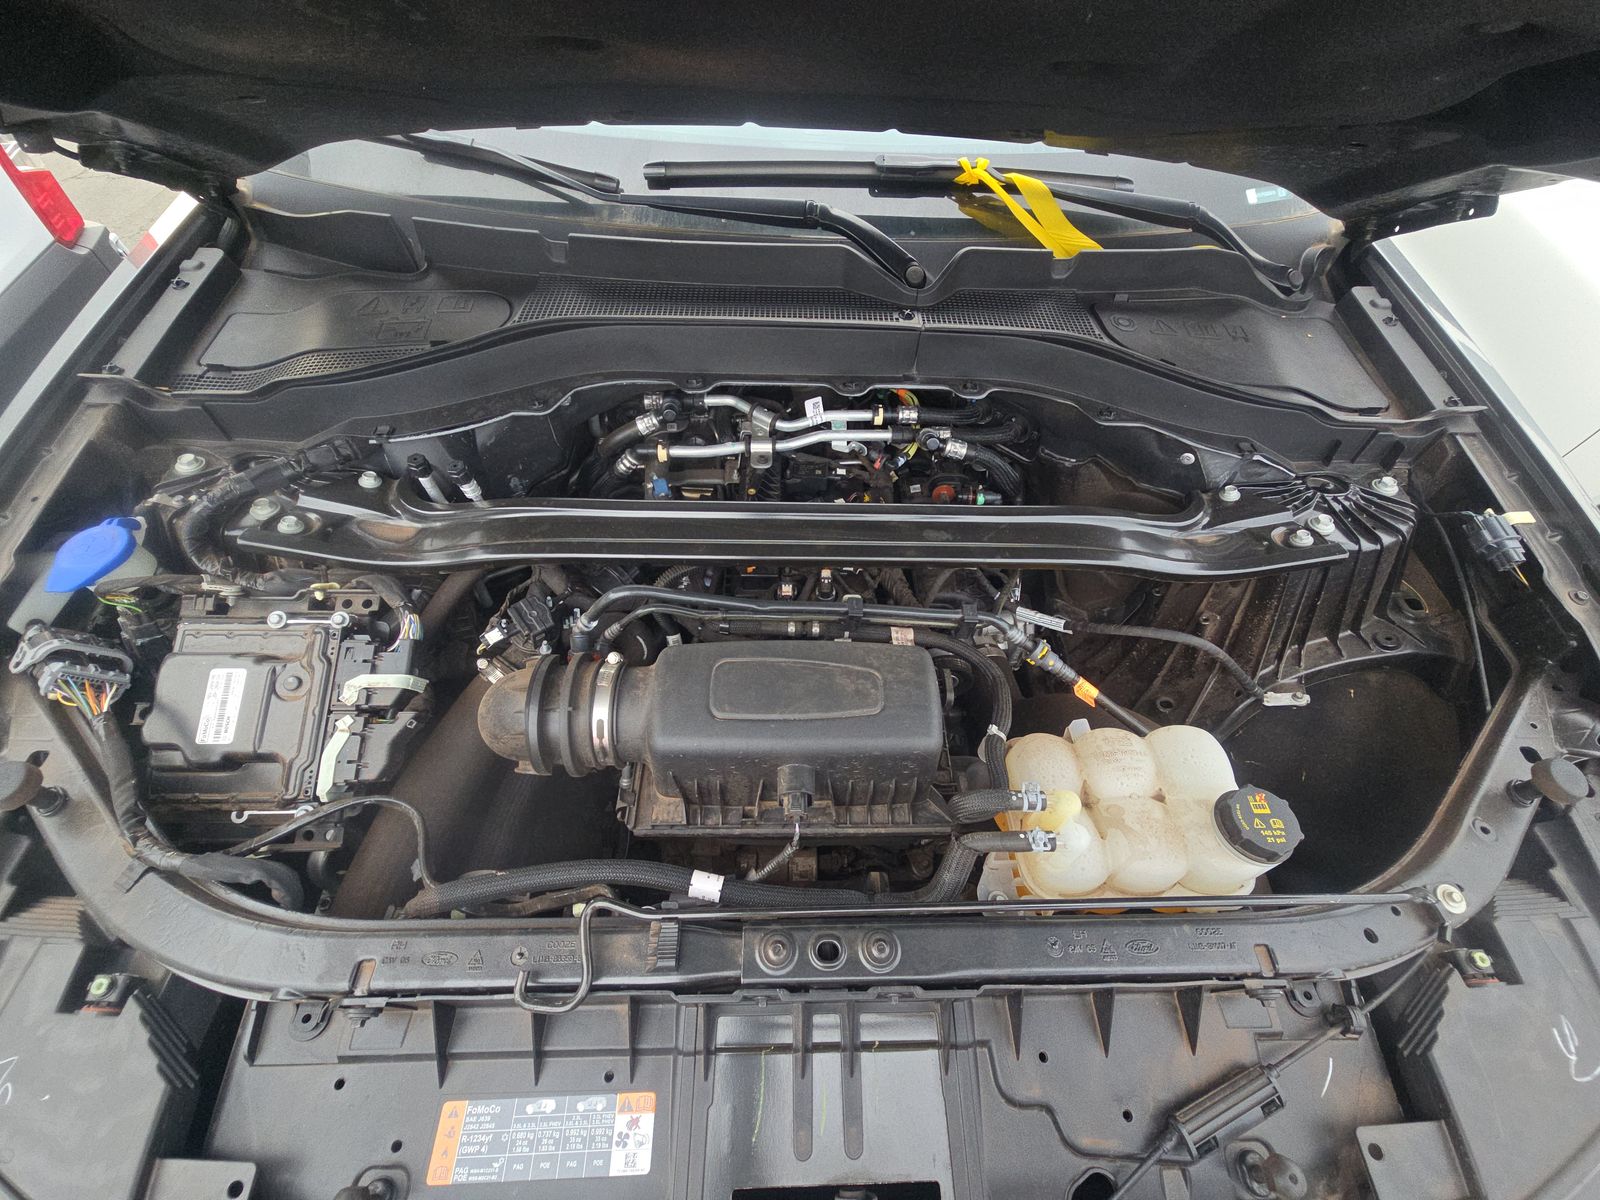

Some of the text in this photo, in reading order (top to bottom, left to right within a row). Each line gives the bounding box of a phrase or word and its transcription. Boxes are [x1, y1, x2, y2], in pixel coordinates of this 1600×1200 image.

[467, 1105, 501, 1114] FoMoCo
[461, 1134, 493, 1143] R-1234yf
[459, 1144, 488, 1154] (GWP 4)
[455, 1167, 469, 1175] PAG
[453, 1174, 467, 1182] POE
